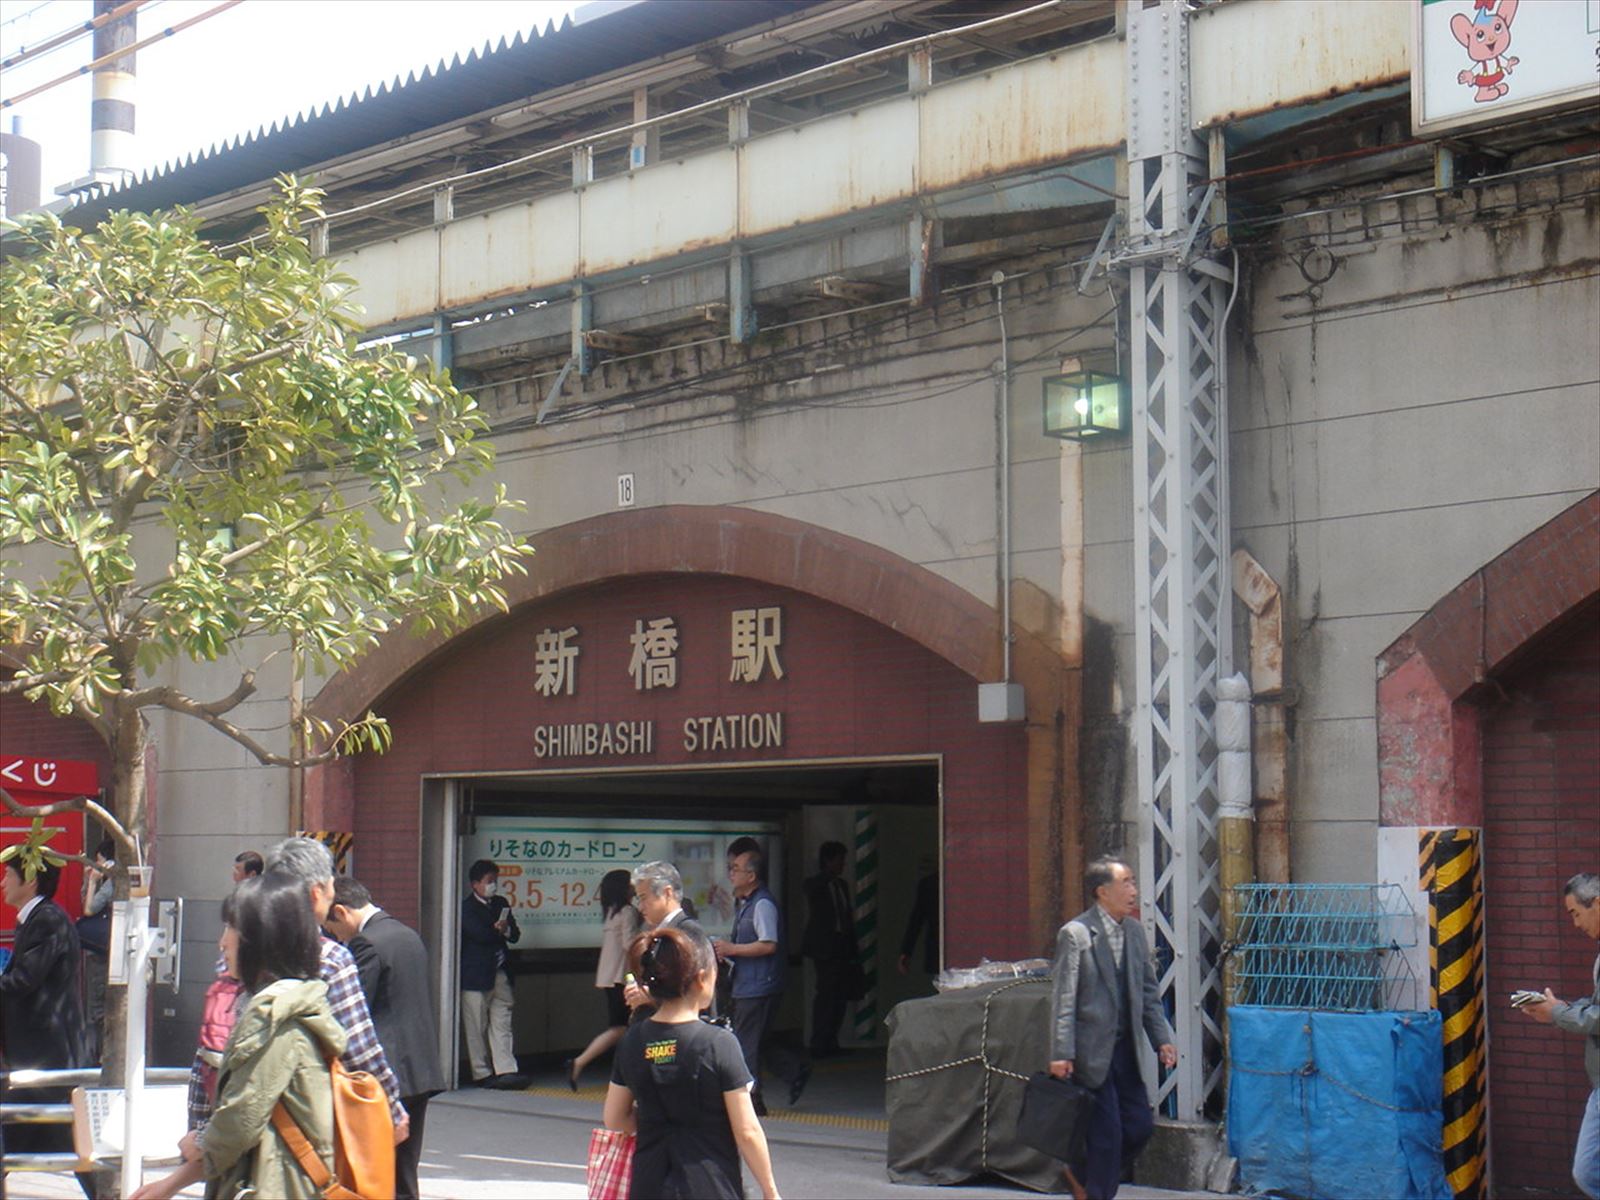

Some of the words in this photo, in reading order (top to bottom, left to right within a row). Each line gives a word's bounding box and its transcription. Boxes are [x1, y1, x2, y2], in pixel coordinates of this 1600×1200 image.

[620, 478, 632, 502] 18
[534, 607, 784, 697] 新橋駅
[534, 720, 653, 758] SHIMBASHI
[683, 712, 782, 752] STATION
[489, 839, 646, 859] りそなのカードローン
[644, 1044, 678, 1060] SHAKE
